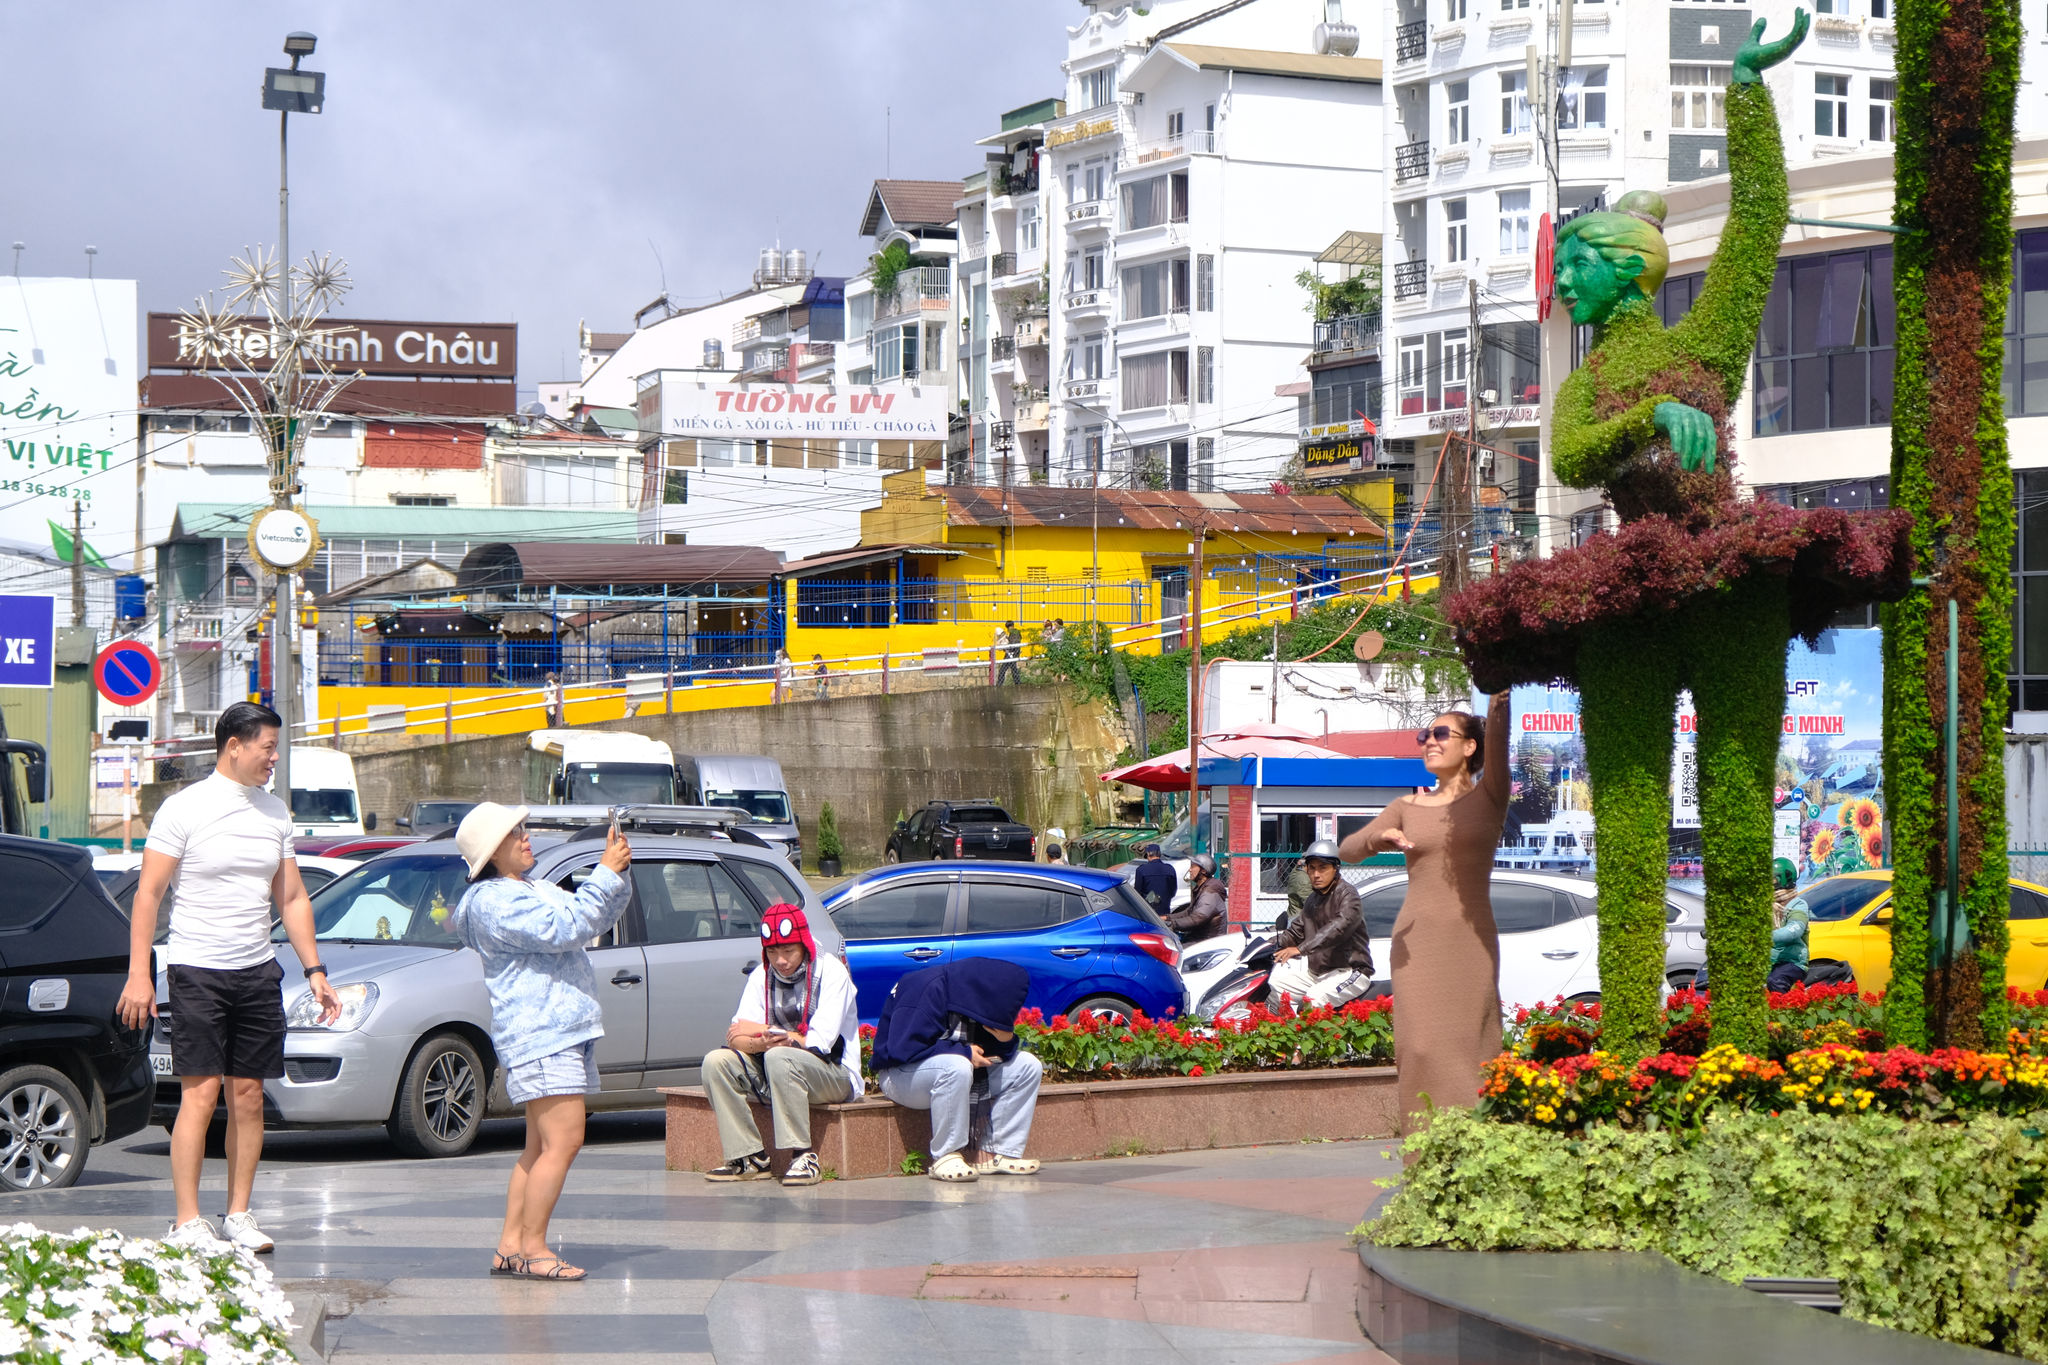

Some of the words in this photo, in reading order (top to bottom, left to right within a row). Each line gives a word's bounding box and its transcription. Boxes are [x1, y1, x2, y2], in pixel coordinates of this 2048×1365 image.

[395, 331, 499, 365] Châu
[715, 389, 837, 413] TƯỜNG
[850, 393, 896, 414] VY
[713, 417, 733, 430] GÀ
[745, 418, 770, 430] XÔI
[774, 418, 793, 430] GÀ
[873, 420, 914, 432] CHÁO
[917, 420, 937, 432] GÀ
[7, 440, 35, 469] VỊ
[44, 442, 114, 475] VIỆT
[25, 482, 44, 495] 36
[49, 485, 68, 498] 28
[72, 488, 92, 501] 28
[261, 533, 308, 544] Vietcombank
[4, 638, 35, 664] XE
[1786, 681, 1818, 697] LẠT
[1521, 711, 1574, 731] CHÍNH
[1798, 716, 1843, 733] MINH
[153, 1057, 172, 1072] 49A
